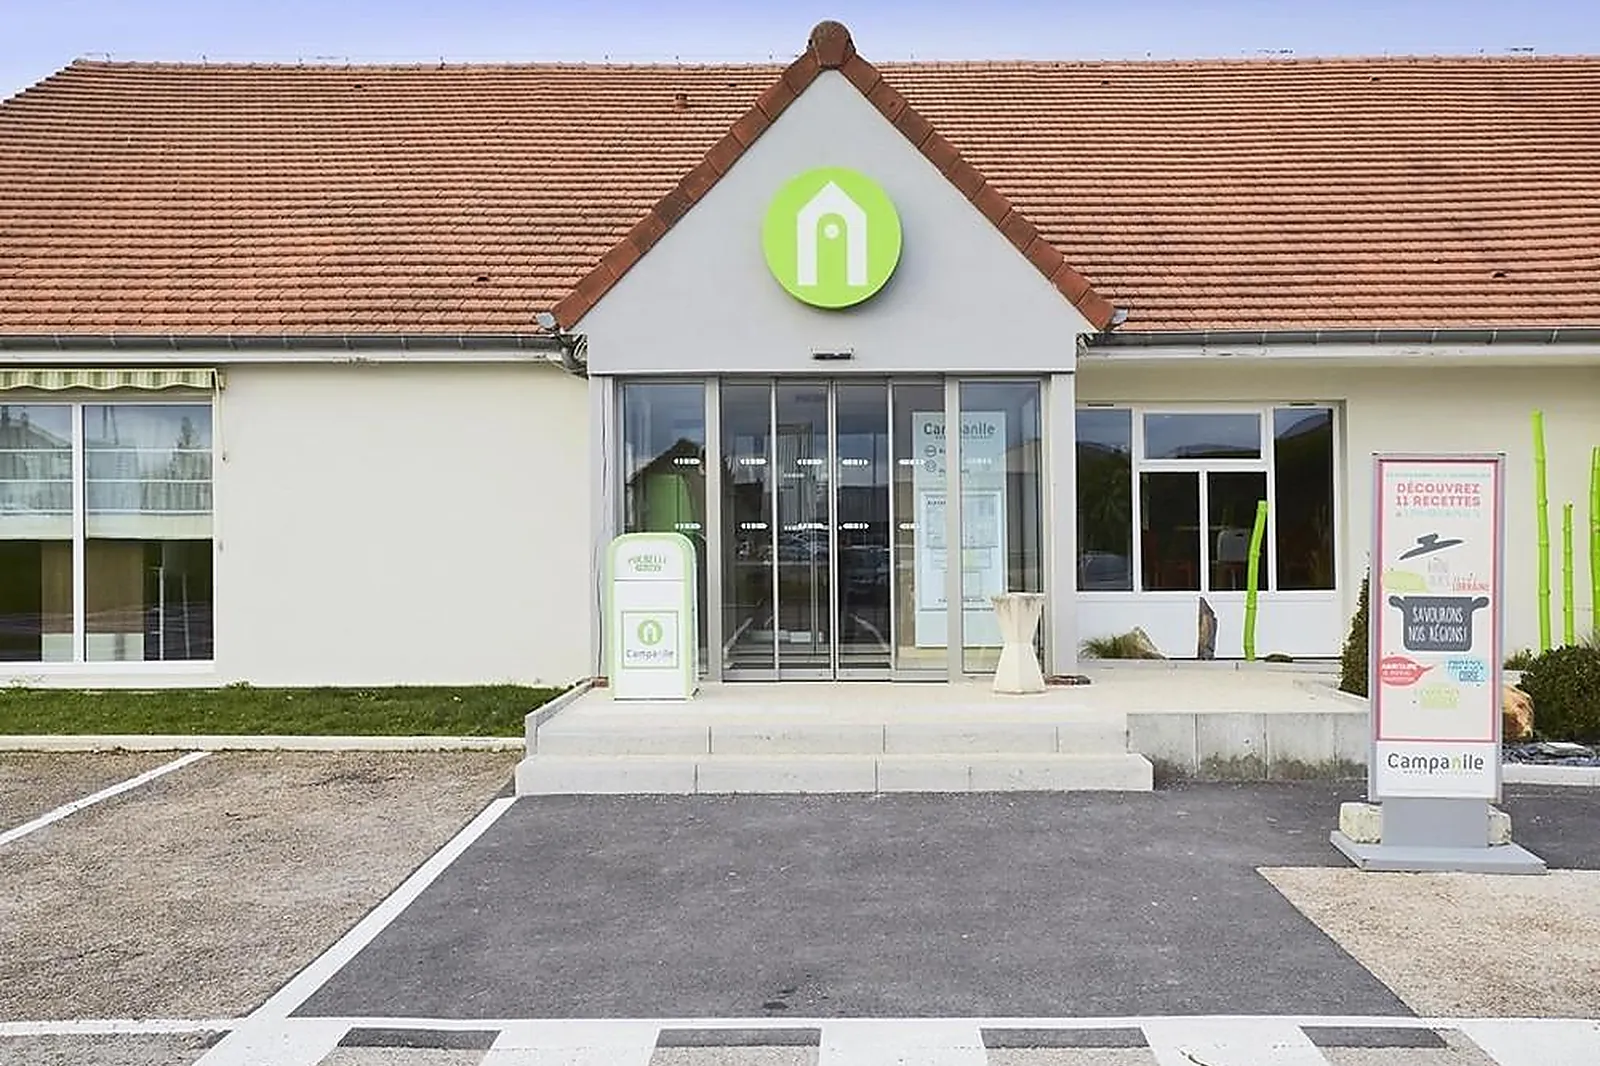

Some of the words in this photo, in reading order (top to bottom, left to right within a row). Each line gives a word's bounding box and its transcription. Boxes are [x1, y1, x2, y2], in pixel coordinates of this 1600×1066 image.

[923, 422, 996, 435] Caanile
[1397, 481, 1481, 494] DÉCOUVREZ
[1396, 496, 1408, 507] 11
[1413, 496, 1481, 507] RECETTES
[1413, 605, 1463, 623] SAVOURONS
[1408, 626, 1425, 642] NOS
[1387, 753, 1484, 774] Campanile
